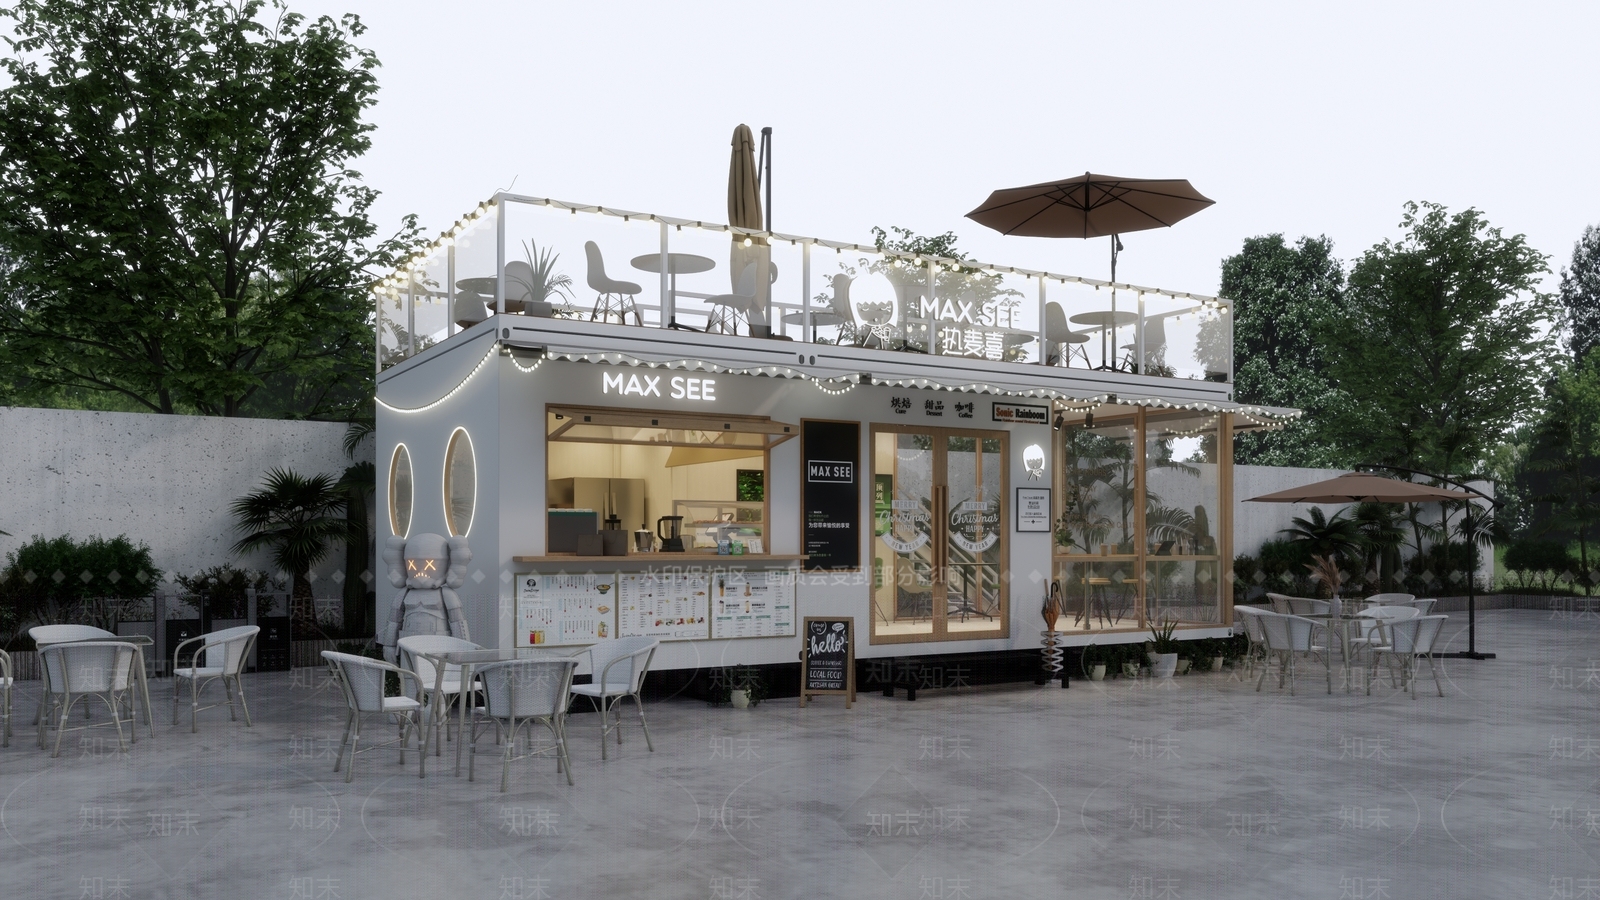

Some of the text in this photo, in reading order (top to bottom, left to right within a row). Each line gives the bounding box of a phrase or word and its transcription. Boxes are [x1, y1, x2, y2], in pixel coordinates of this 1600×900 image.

[920, 295, 1023, 329] MAX SEE
[603, 371, 716, 401] MAX SEE
[891, 396, 912, 409] 烘焙
[924, 399, 944, 410] 甜品
[954, 401, 975, 413] 咖啡
[996, 407, 1045, 419] Sonic Rainboom
[811, 465, 851, 478] MAX SEE
[894, 501, 917, 509] MERRY
[965, 502, 986, 510] MERRY
[879, 510, 930, 525] Christmas
[951, 511, 999, 526] Christmas
[965, 525, 985, 533] HAPPY
[891, 540, 903, 550] NEW
[962, 540, 989, 550] NEW YEAR
[811, 633, 845, 656] hello
[810, 670, 842, 679] LOCAL FOOD
